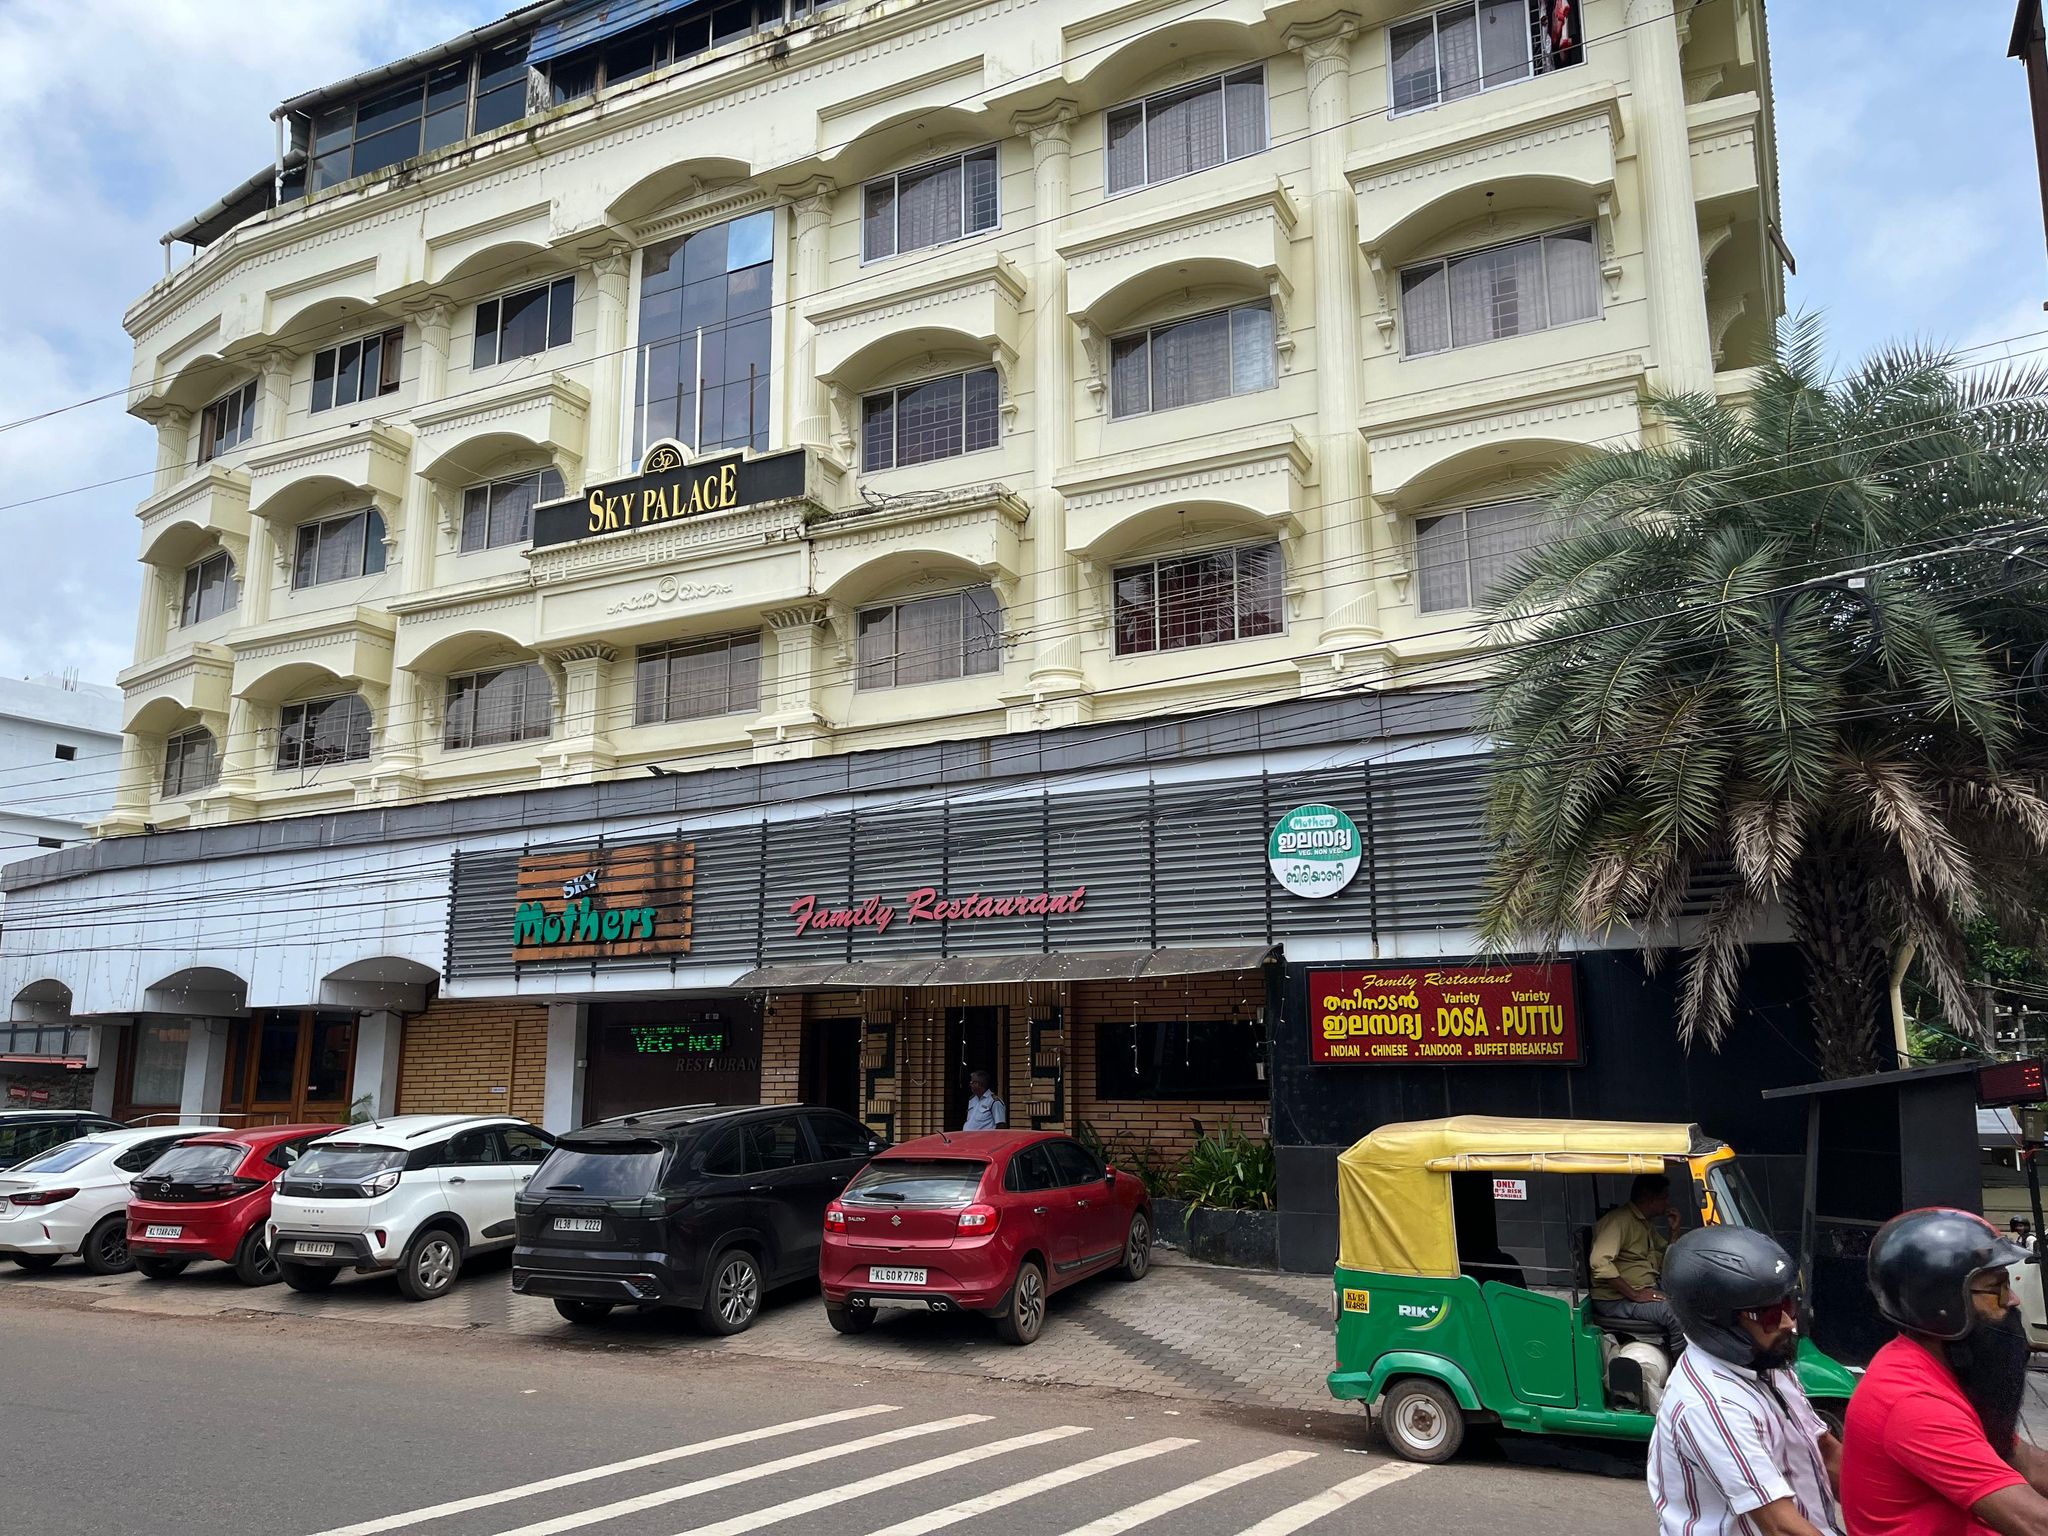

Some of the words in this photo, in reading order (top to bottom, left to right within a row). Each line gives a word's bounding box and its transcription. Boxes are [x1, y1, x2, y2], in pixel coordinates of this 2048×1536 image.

[588, 489, 636, 532] SKY
[641, 463, 738, 523] PALACE
[1294, 817, 1334, 828] Mothers
[1278, 829, 1352, 853] ഇലസദ്യ
[563, 868, 600, 899] SKY
[1286, 862, 1345, 886] ബിരിയാണി
[513, 896, 657, 945] Mothers
[789, 894, 896, 937] Family
[905, 885, 1086, 925] Restaurant
[1361, 973, 1418, 990] Family
[1423, 972, 1513, 987] Restaurant
[1323, 988, 1419, 1012] തനിനാടൻ
[1443, 991, 1480, 1006] Variety
[1511, 989, 1550, 1004] Variety
[1322, 1013, 1423, 1041] ഇലസദ്യ
[1436, 1006, 1489, 1037] DOSA
[1501, 1004, 1564, 1036] PUTTU
[635, 1036, 673, 1053] VEG
[1330, 1044, 1360, 1057] INDIAN
[1371, 1044, 1408, 1057] CHINESE
[1419, 1043, 1463, 1056] TANDOOR
[1474, 1042, 1509, 1055] BUFFET
[1510, 1042, 1564, 1055] BREAKFAST
[584, 1220, 600, 1231] 2222
